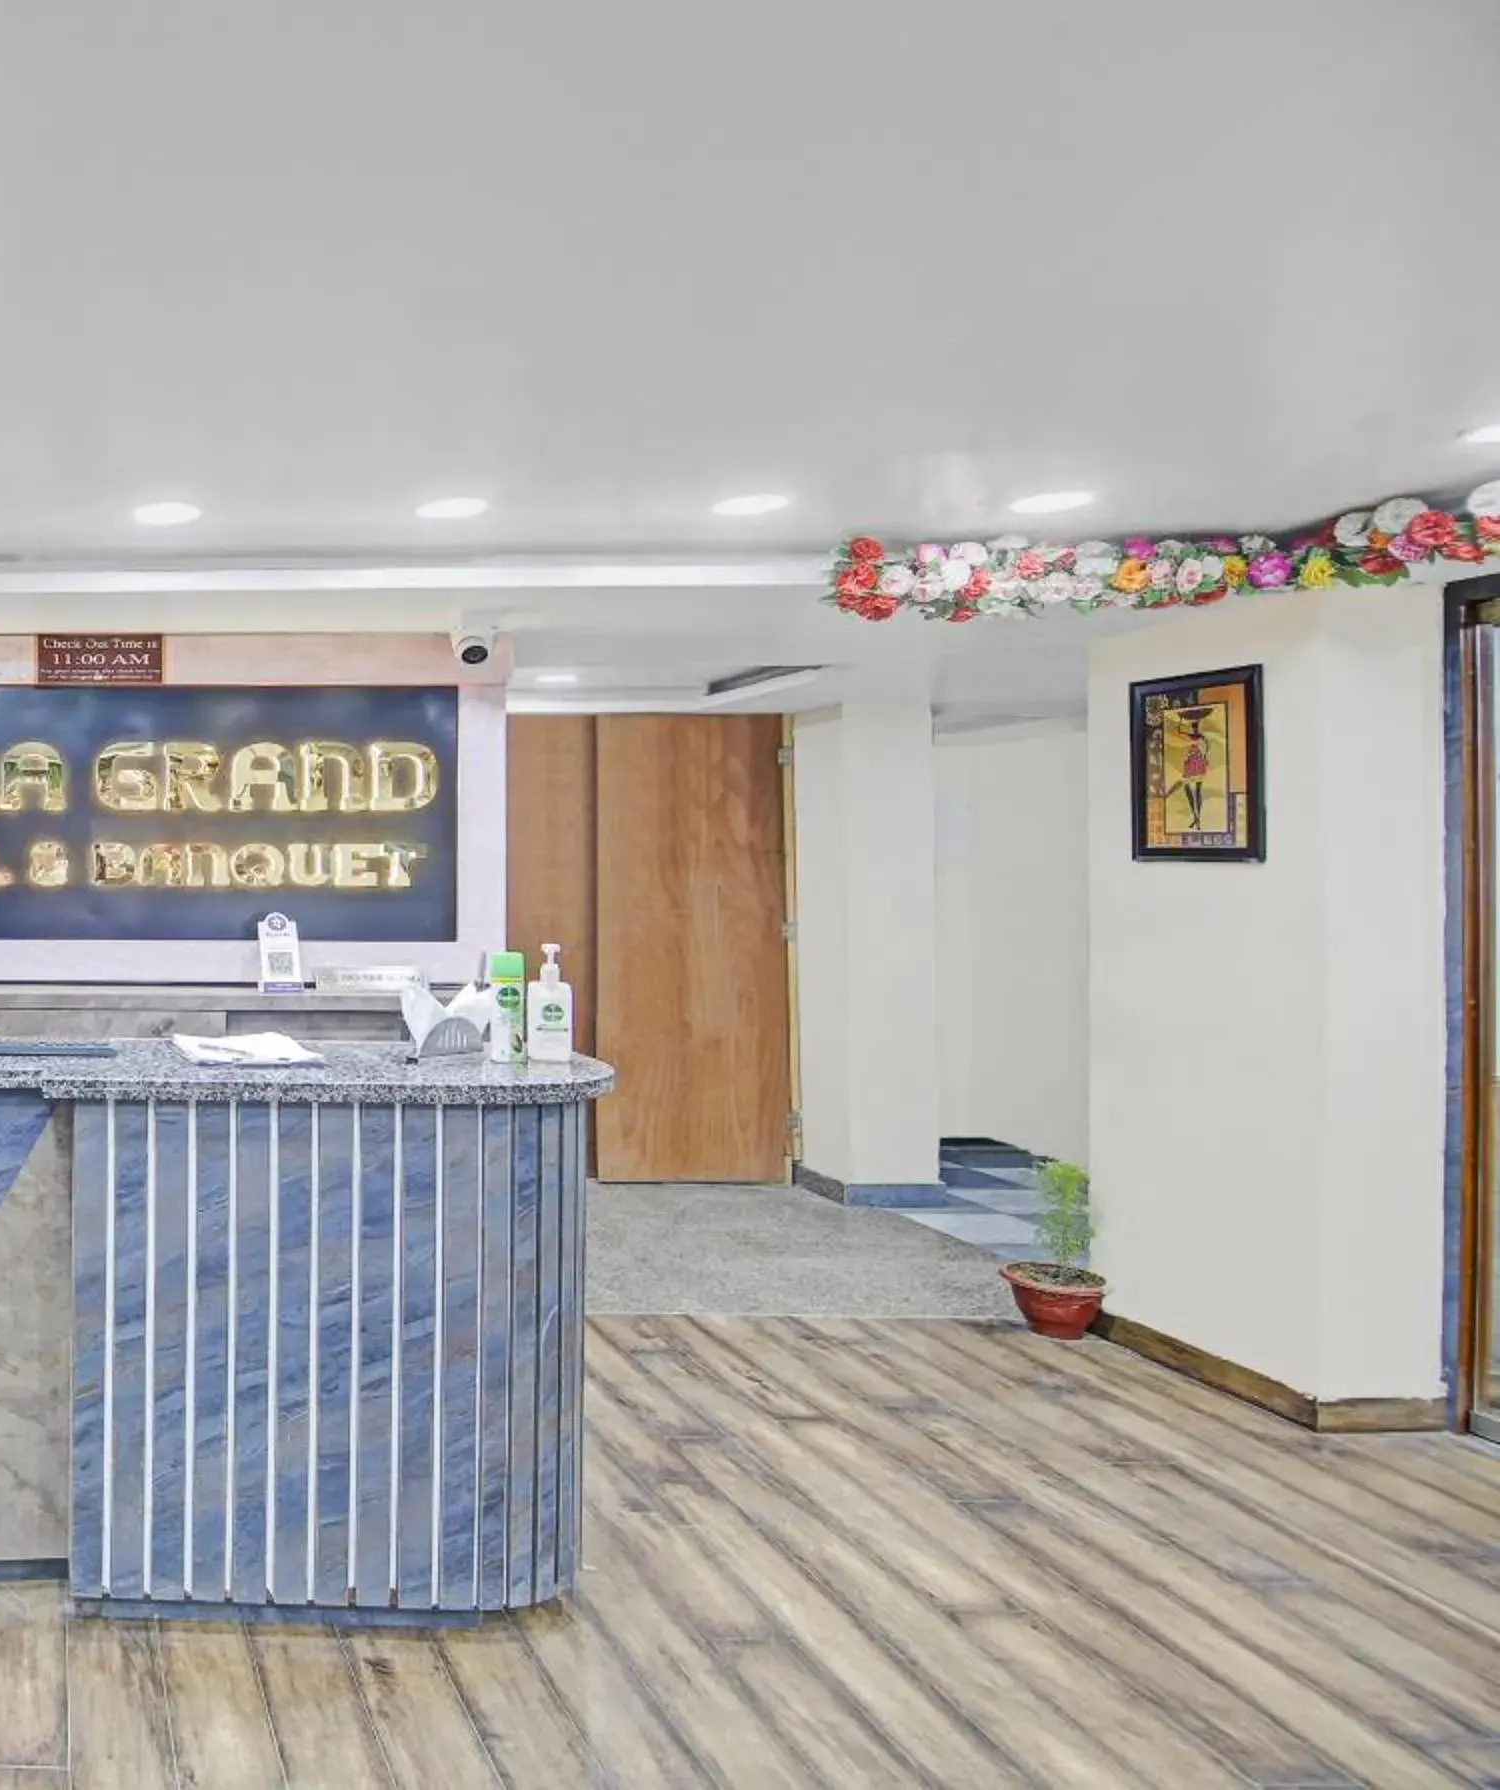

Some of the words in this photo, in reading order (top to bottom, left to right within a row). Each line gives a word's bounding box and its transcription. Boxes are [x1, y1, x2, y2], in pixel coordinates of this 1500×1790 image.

[43, 638, 81, 649] Check
[113, 638, 143, 649] Time
[52, 653, 105, 665] 11:00
[111, 653, 150, 665] AM
[96, 740, 436, 811] GRAND
[29, 841, 69, 887] &
[92, 842, 428, 887] BANQUET
